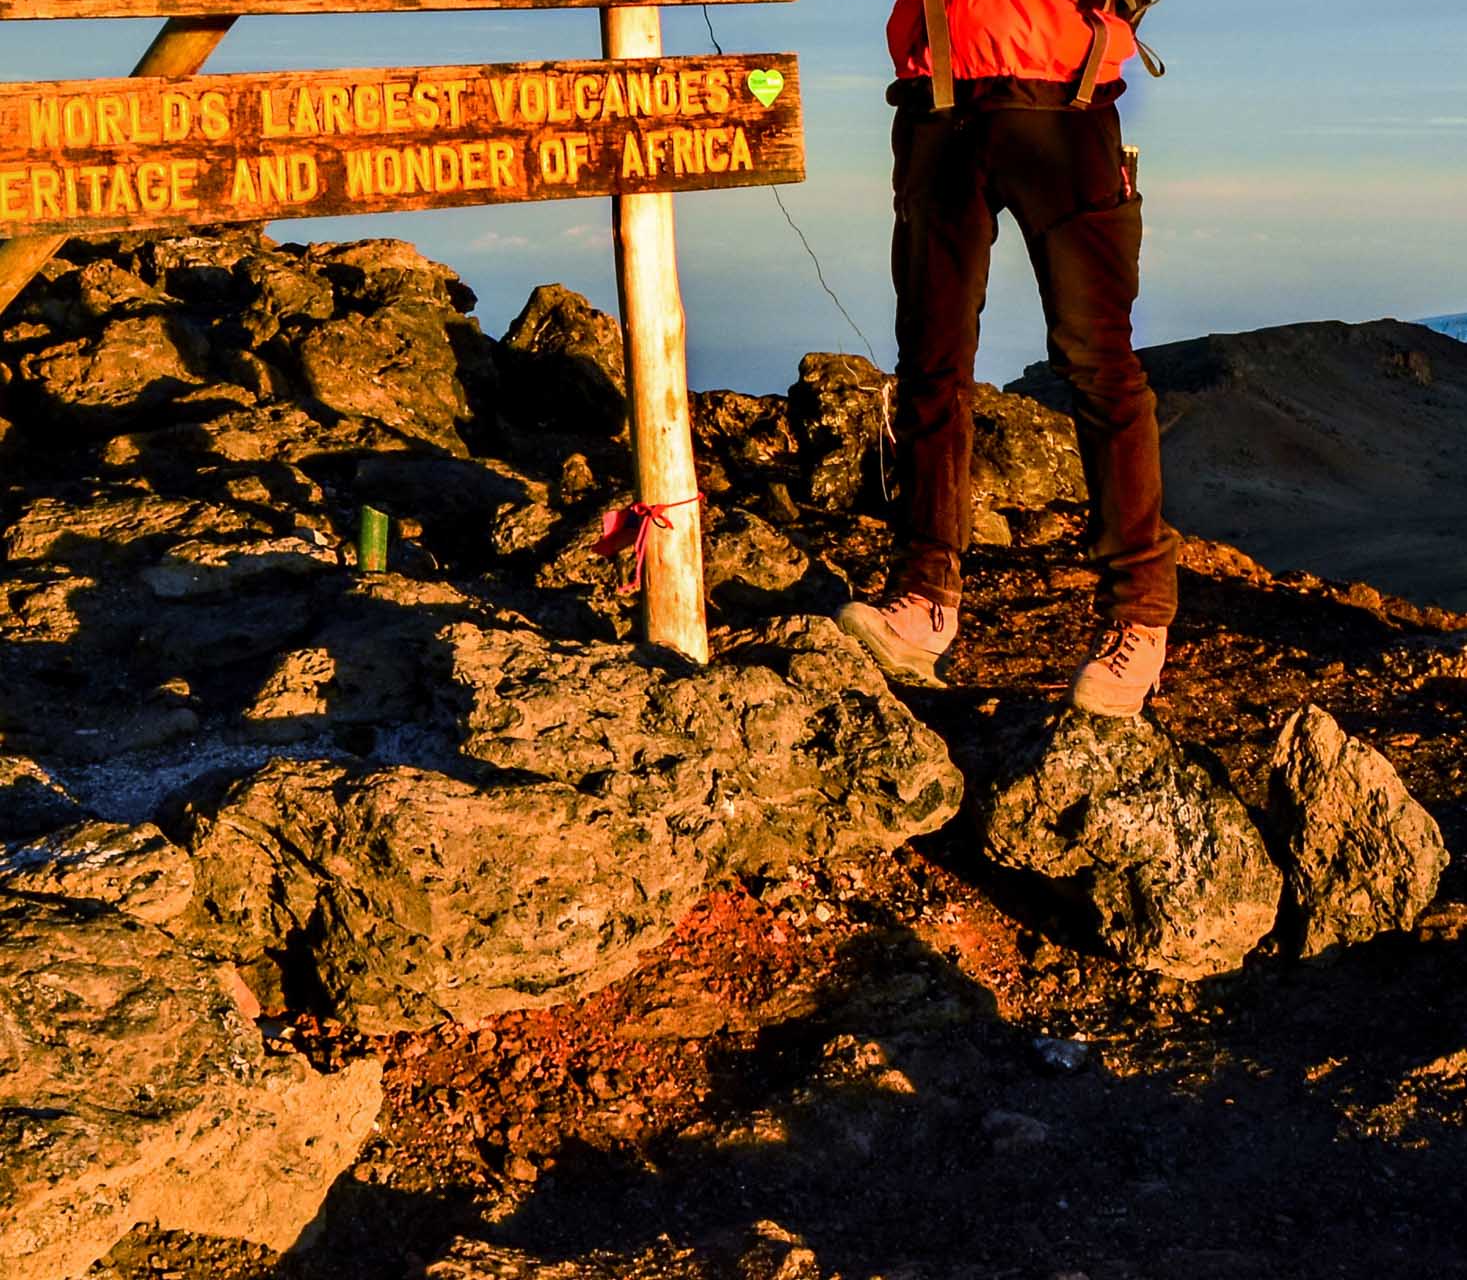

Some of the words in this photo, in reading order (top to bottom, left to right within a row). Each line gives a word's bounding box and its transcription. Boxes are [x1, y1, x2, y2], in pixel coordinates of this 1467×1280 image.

[260, 79, 466, 138] LARGEST
[491, 69, 731, 122] VOLCANOES
[231, 154, 318, 206] AND
[346, 140, 515, 197] WONDER
[540, 132, 591, 186] OF
[621, 126, 754, 179] AFRICA
